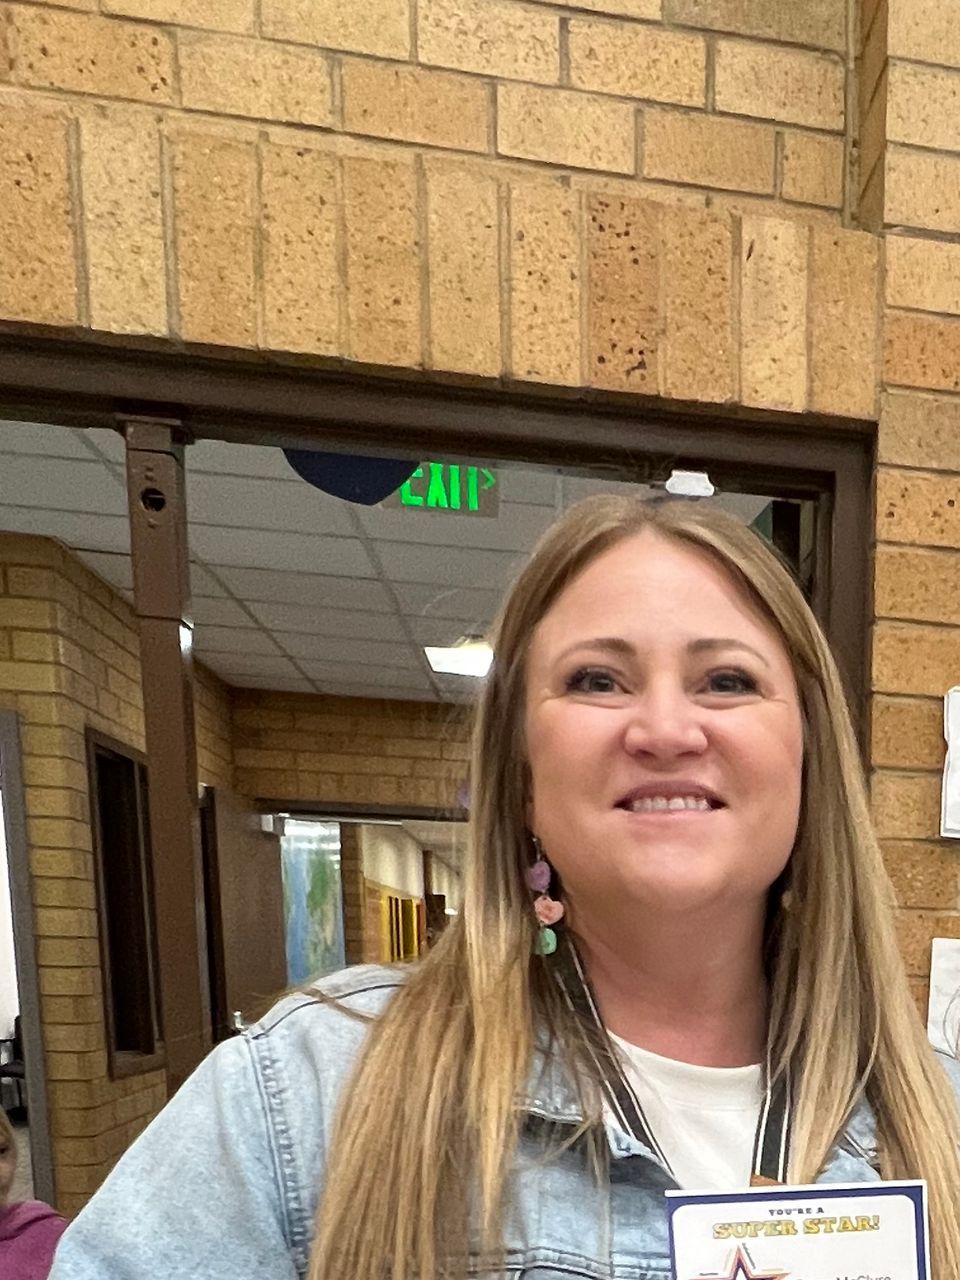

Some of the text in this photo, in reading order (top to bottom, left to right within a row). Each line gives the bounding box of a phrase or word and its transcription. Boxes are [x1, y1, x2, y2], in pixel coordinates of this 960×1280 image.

[400, 462, 479, 511] EXIT
[712, 1215, 880, 1239] SUPER STAR!
